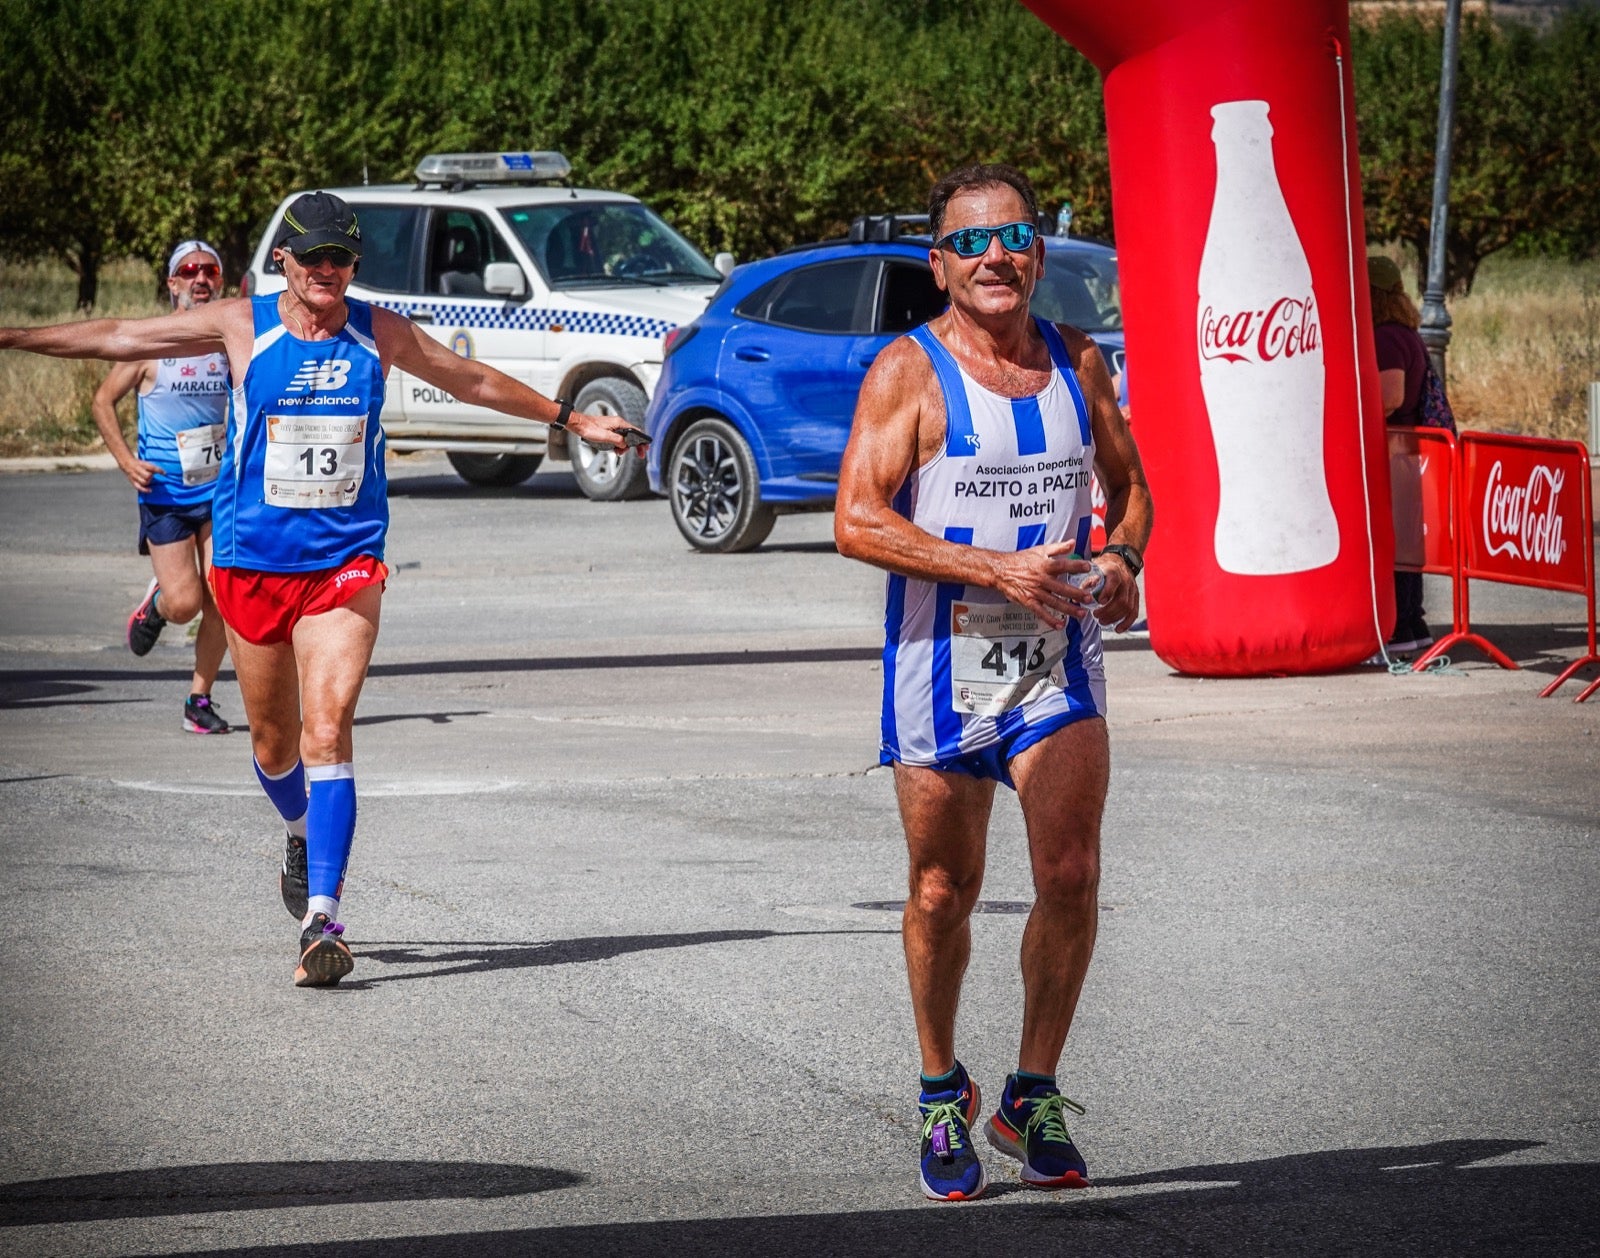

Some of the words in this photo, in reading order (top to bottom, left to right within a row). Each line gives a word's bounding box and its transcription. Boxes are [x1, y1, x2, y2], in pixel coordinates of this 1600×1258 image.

[1200, 296, 1317, 364] Coca-Cola
[278, 397, 303, 406] new
[305, 395, 360, 405] balance
[412, 387, 459, 404] POLIC
[300, 448, 338, 476] 13
[976, 464, 1035, 475] Asociación
[1037, 456, 1083, 473] Deportiva
[955, 480, 1023, 498] PAZITO
[1028, 483, 1038, 495] a
[1043, 471, 1089, 493] PAZITO
[1009, 499, 1055, 519] Motril
[1483, 461, 1567, 565] Coca-Cola
[981, 637, 1046, 677] 416
